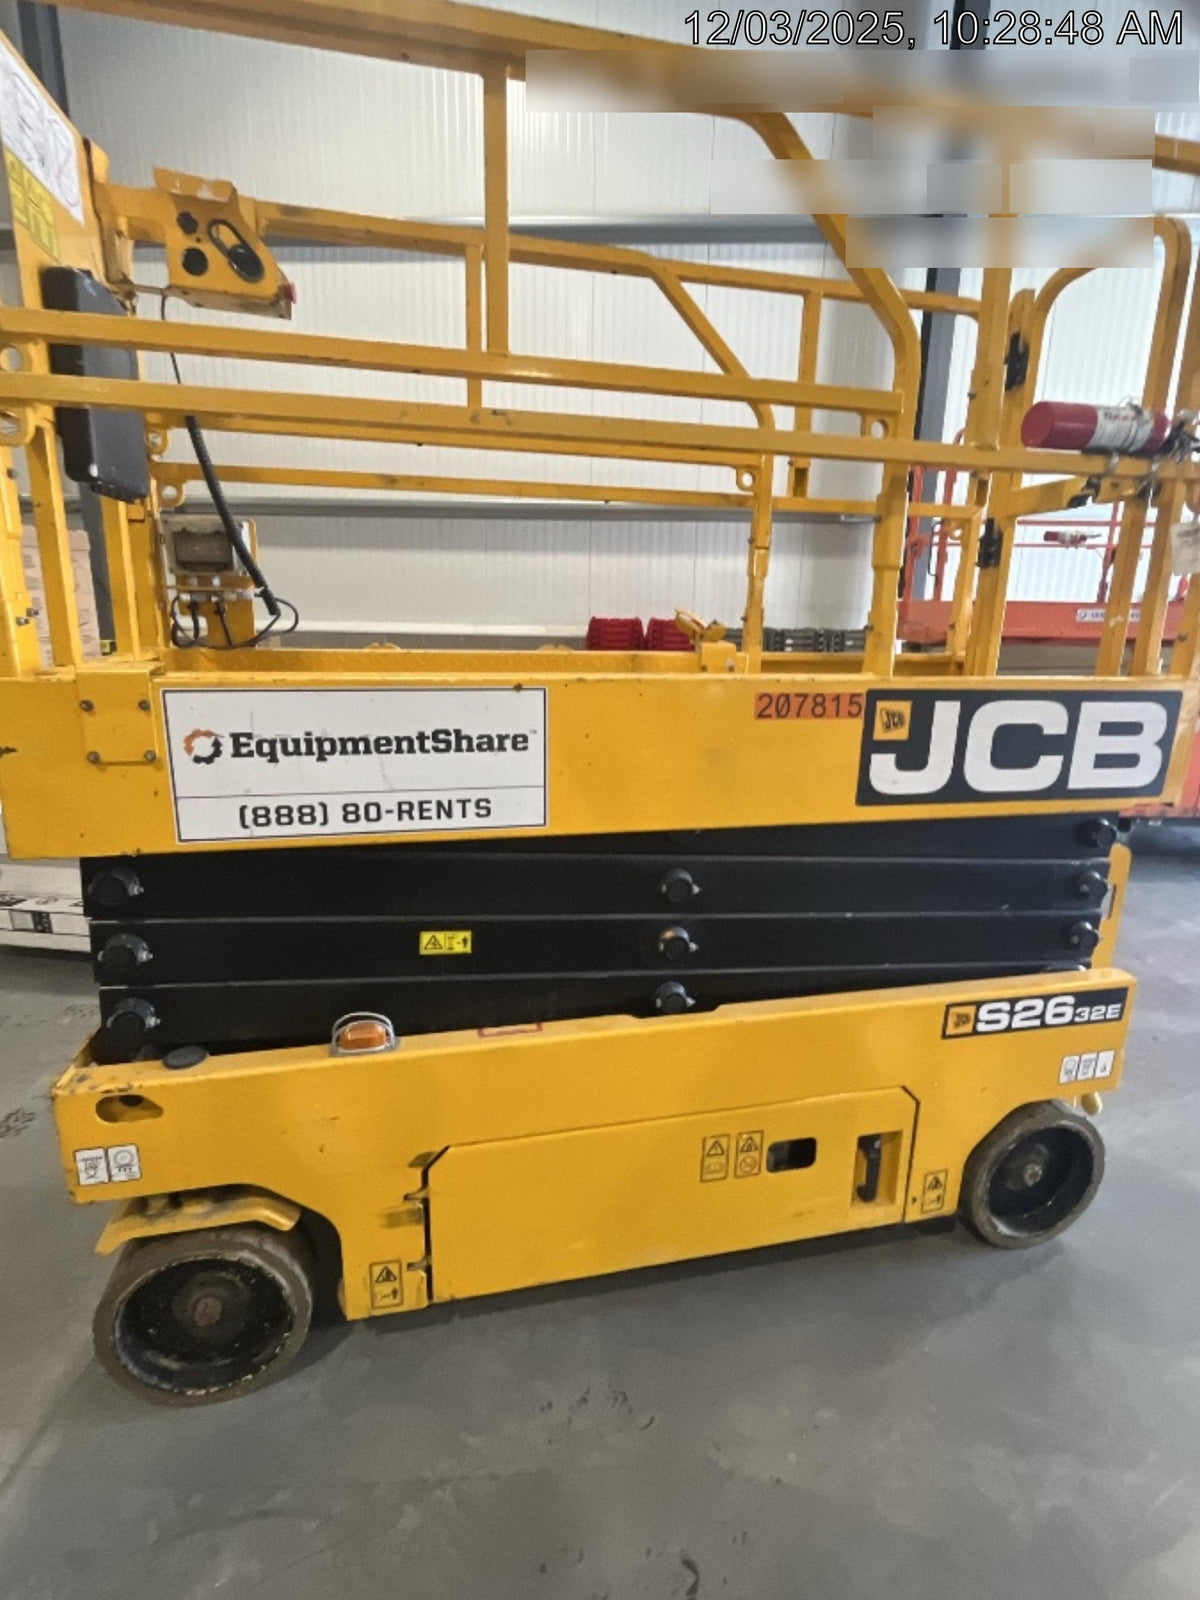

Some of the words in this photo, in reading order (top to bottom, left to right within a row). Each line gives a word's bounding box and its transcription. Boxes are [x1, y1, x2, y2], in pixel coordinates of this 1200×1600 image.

[757, 693, 862, 719] 207815
[231, 729, 529, 762] EquipmentShare
[869, 700, 1168, 795] JCB
[239, 802, 329, 829] (888)
[342, 798, 492, 824] 80-RENTS
